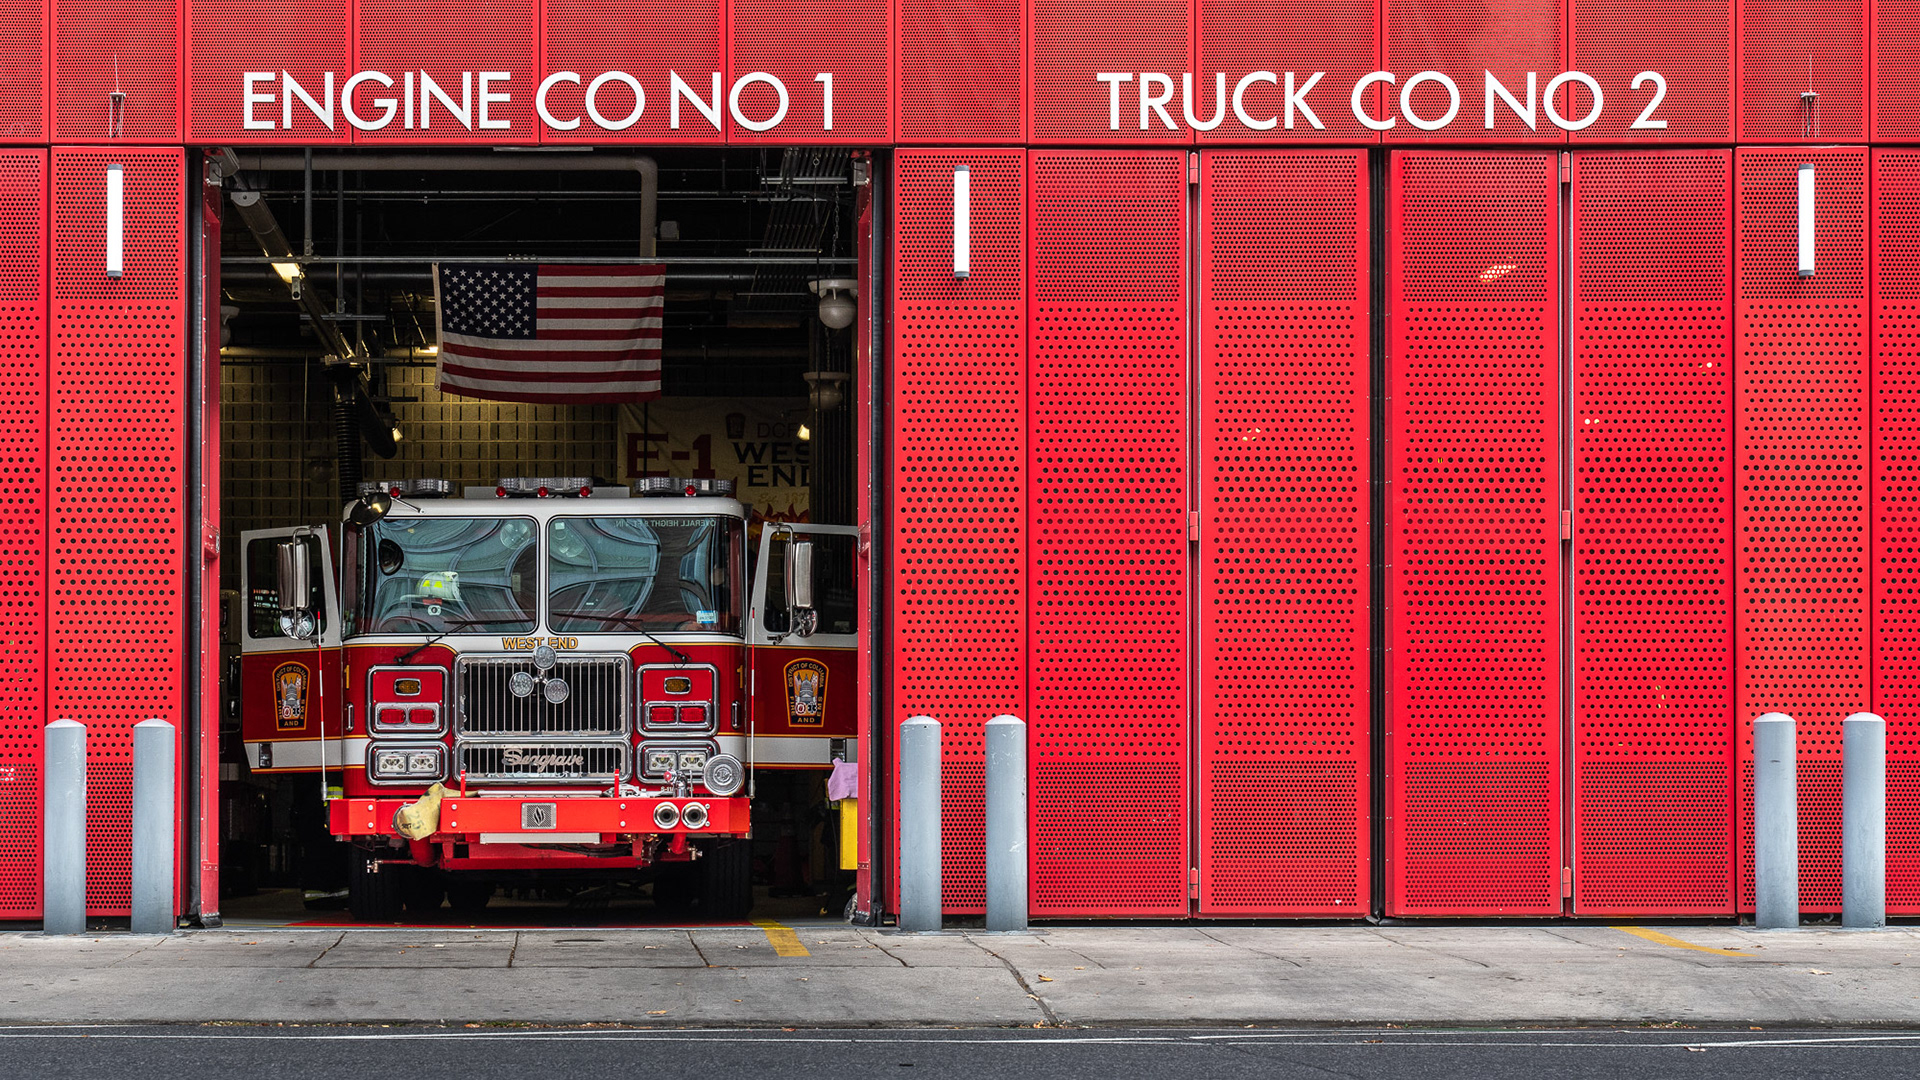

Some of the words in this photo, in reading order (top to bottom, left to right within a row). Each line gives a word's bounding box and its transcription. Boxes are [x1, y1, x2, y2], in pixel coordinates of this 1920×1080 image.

[243, 69, 511, 132] ENGINE
[535, 71, 646, 132] CO
[670, 69, 790, 132] NO
[813, 72, 833, 130] 1
[1096, 70, 1327, 131] TRUCK
[1350, 69, 1461, 132] CO
[1484, 69, 1604, 132] NO
[1629, 69, 1668, 130] 2
[626, 432, 716, 479] E-1
[502, 636, 545, 650] WEST
[548, 636, 579, 650] END
[736, 665, 743, 688] 1
[788, 663, 800, 687] DISTRICT
[808, 663, 825, 688] COLUMBIA
[501, 747, 585, 773] Seagrave
